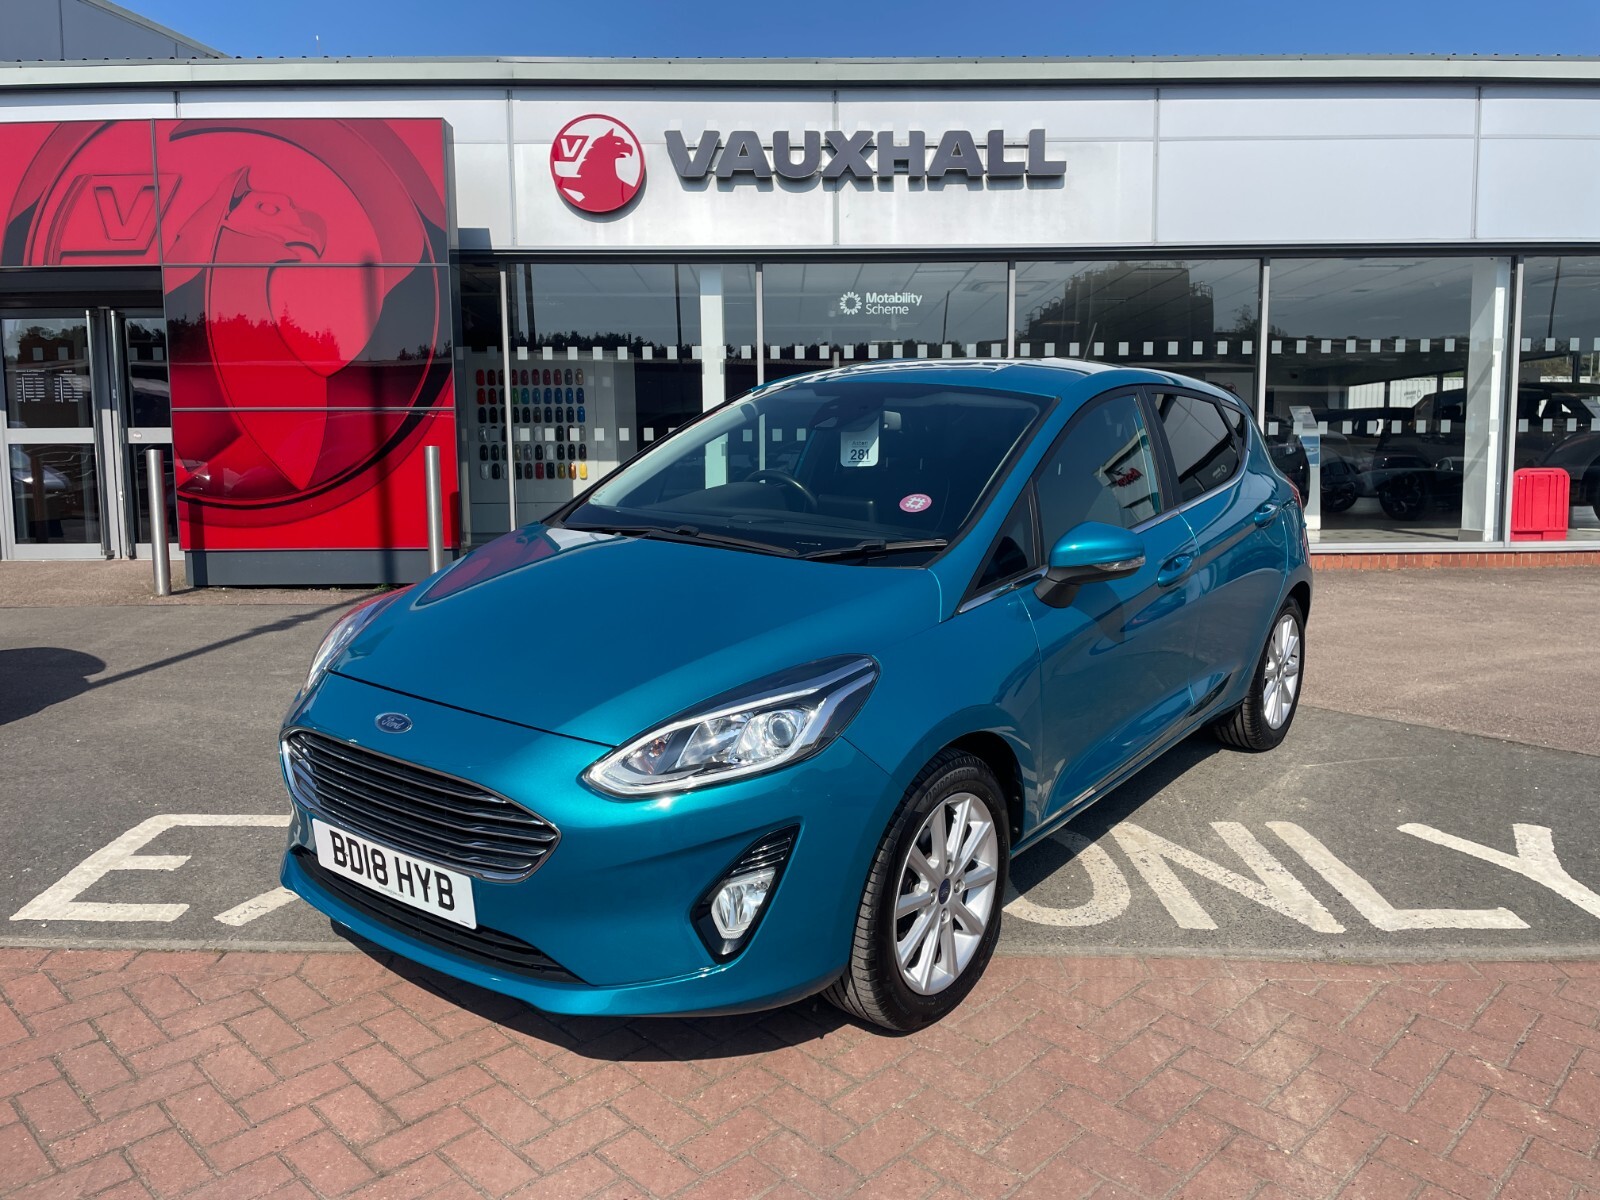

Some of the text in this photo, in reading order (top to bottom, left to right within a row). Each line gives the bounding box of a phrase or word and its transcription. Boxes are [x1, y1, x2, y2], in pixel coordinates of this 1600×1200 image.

[664, 129, 1067, 179] VAUXHALL
[865, 292, 923, 306] Motability
[865, 303, 909, 315] Scheme
[850, 448, 870, 460] 281
[381, 715, 405, 730] Ford
[329, 829, 455, 912] BD18 HYB
